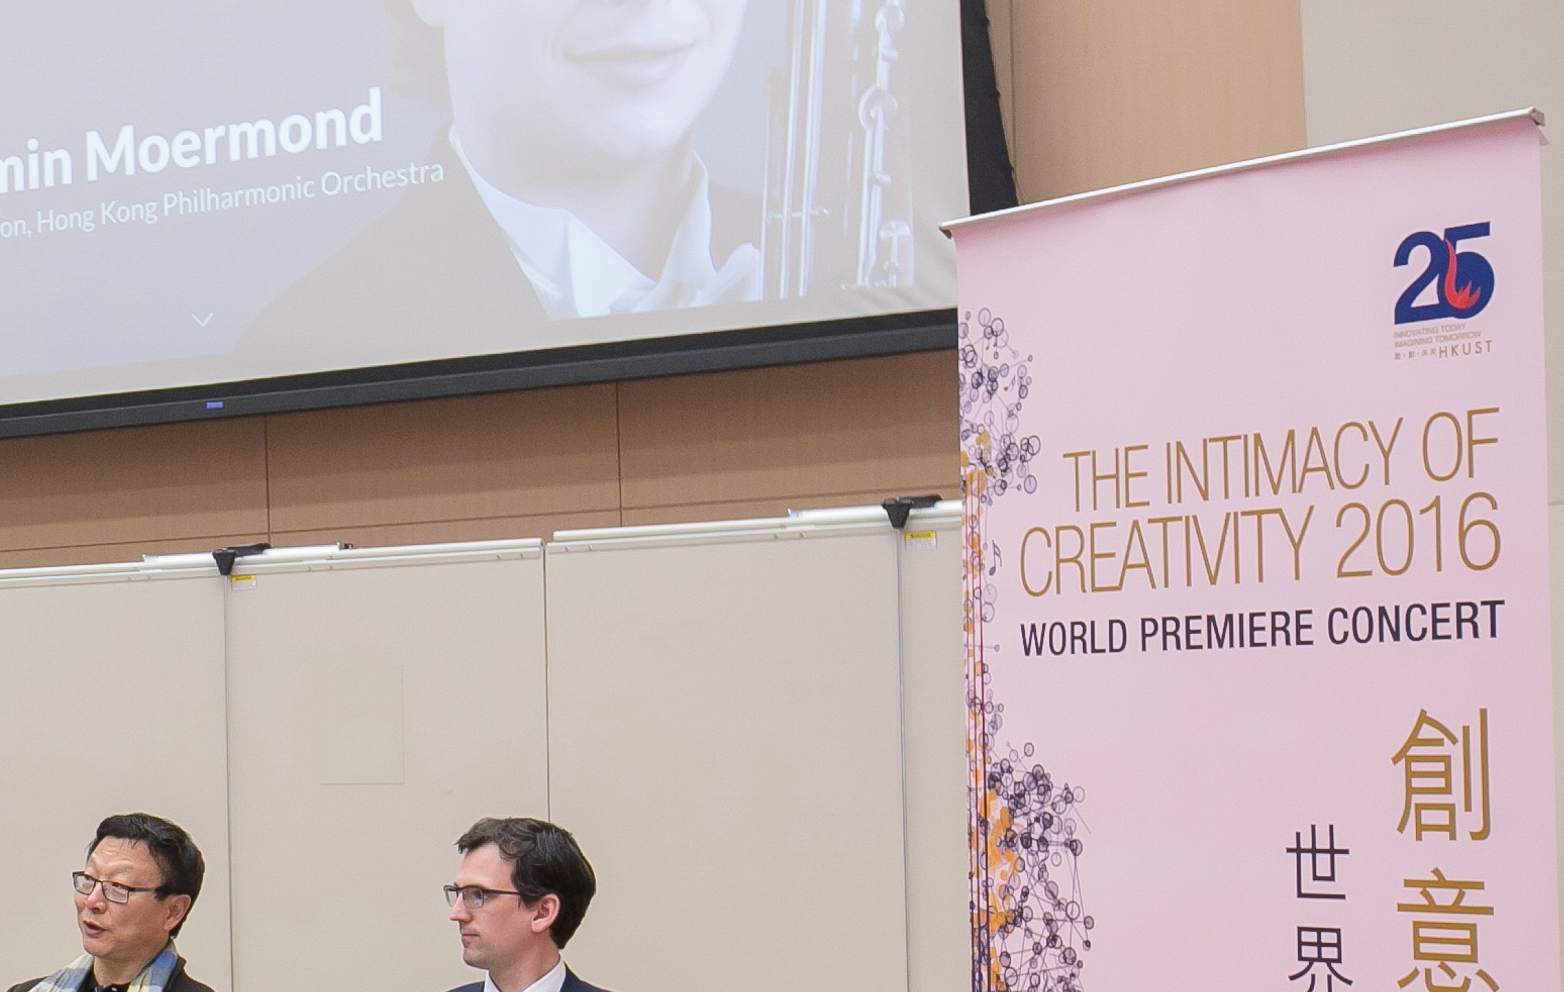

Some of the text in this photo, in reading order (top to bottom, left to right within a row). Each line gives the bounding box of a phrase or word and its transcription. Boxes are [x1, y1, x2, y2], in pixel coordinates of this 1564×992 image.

[85, 86, 384, 182] Moermond
[37, 203, 95, 234] Hong
[101, 197, 158, 226] Kong
[164, 174, 315, 217] Philharmonic
[320, 160, 444, 197] Orchestra
[1393, 221, 1495, 325] 25
[1438, 340, 1493, 358] HKUST
[1062, 407, 1500, 513] THE INTIMACY OF
[1020, 491, 1502, 598] CREATIVITY 2016
[1020, 600, 1506, 657] WORLD PREMIERE CONCERT
